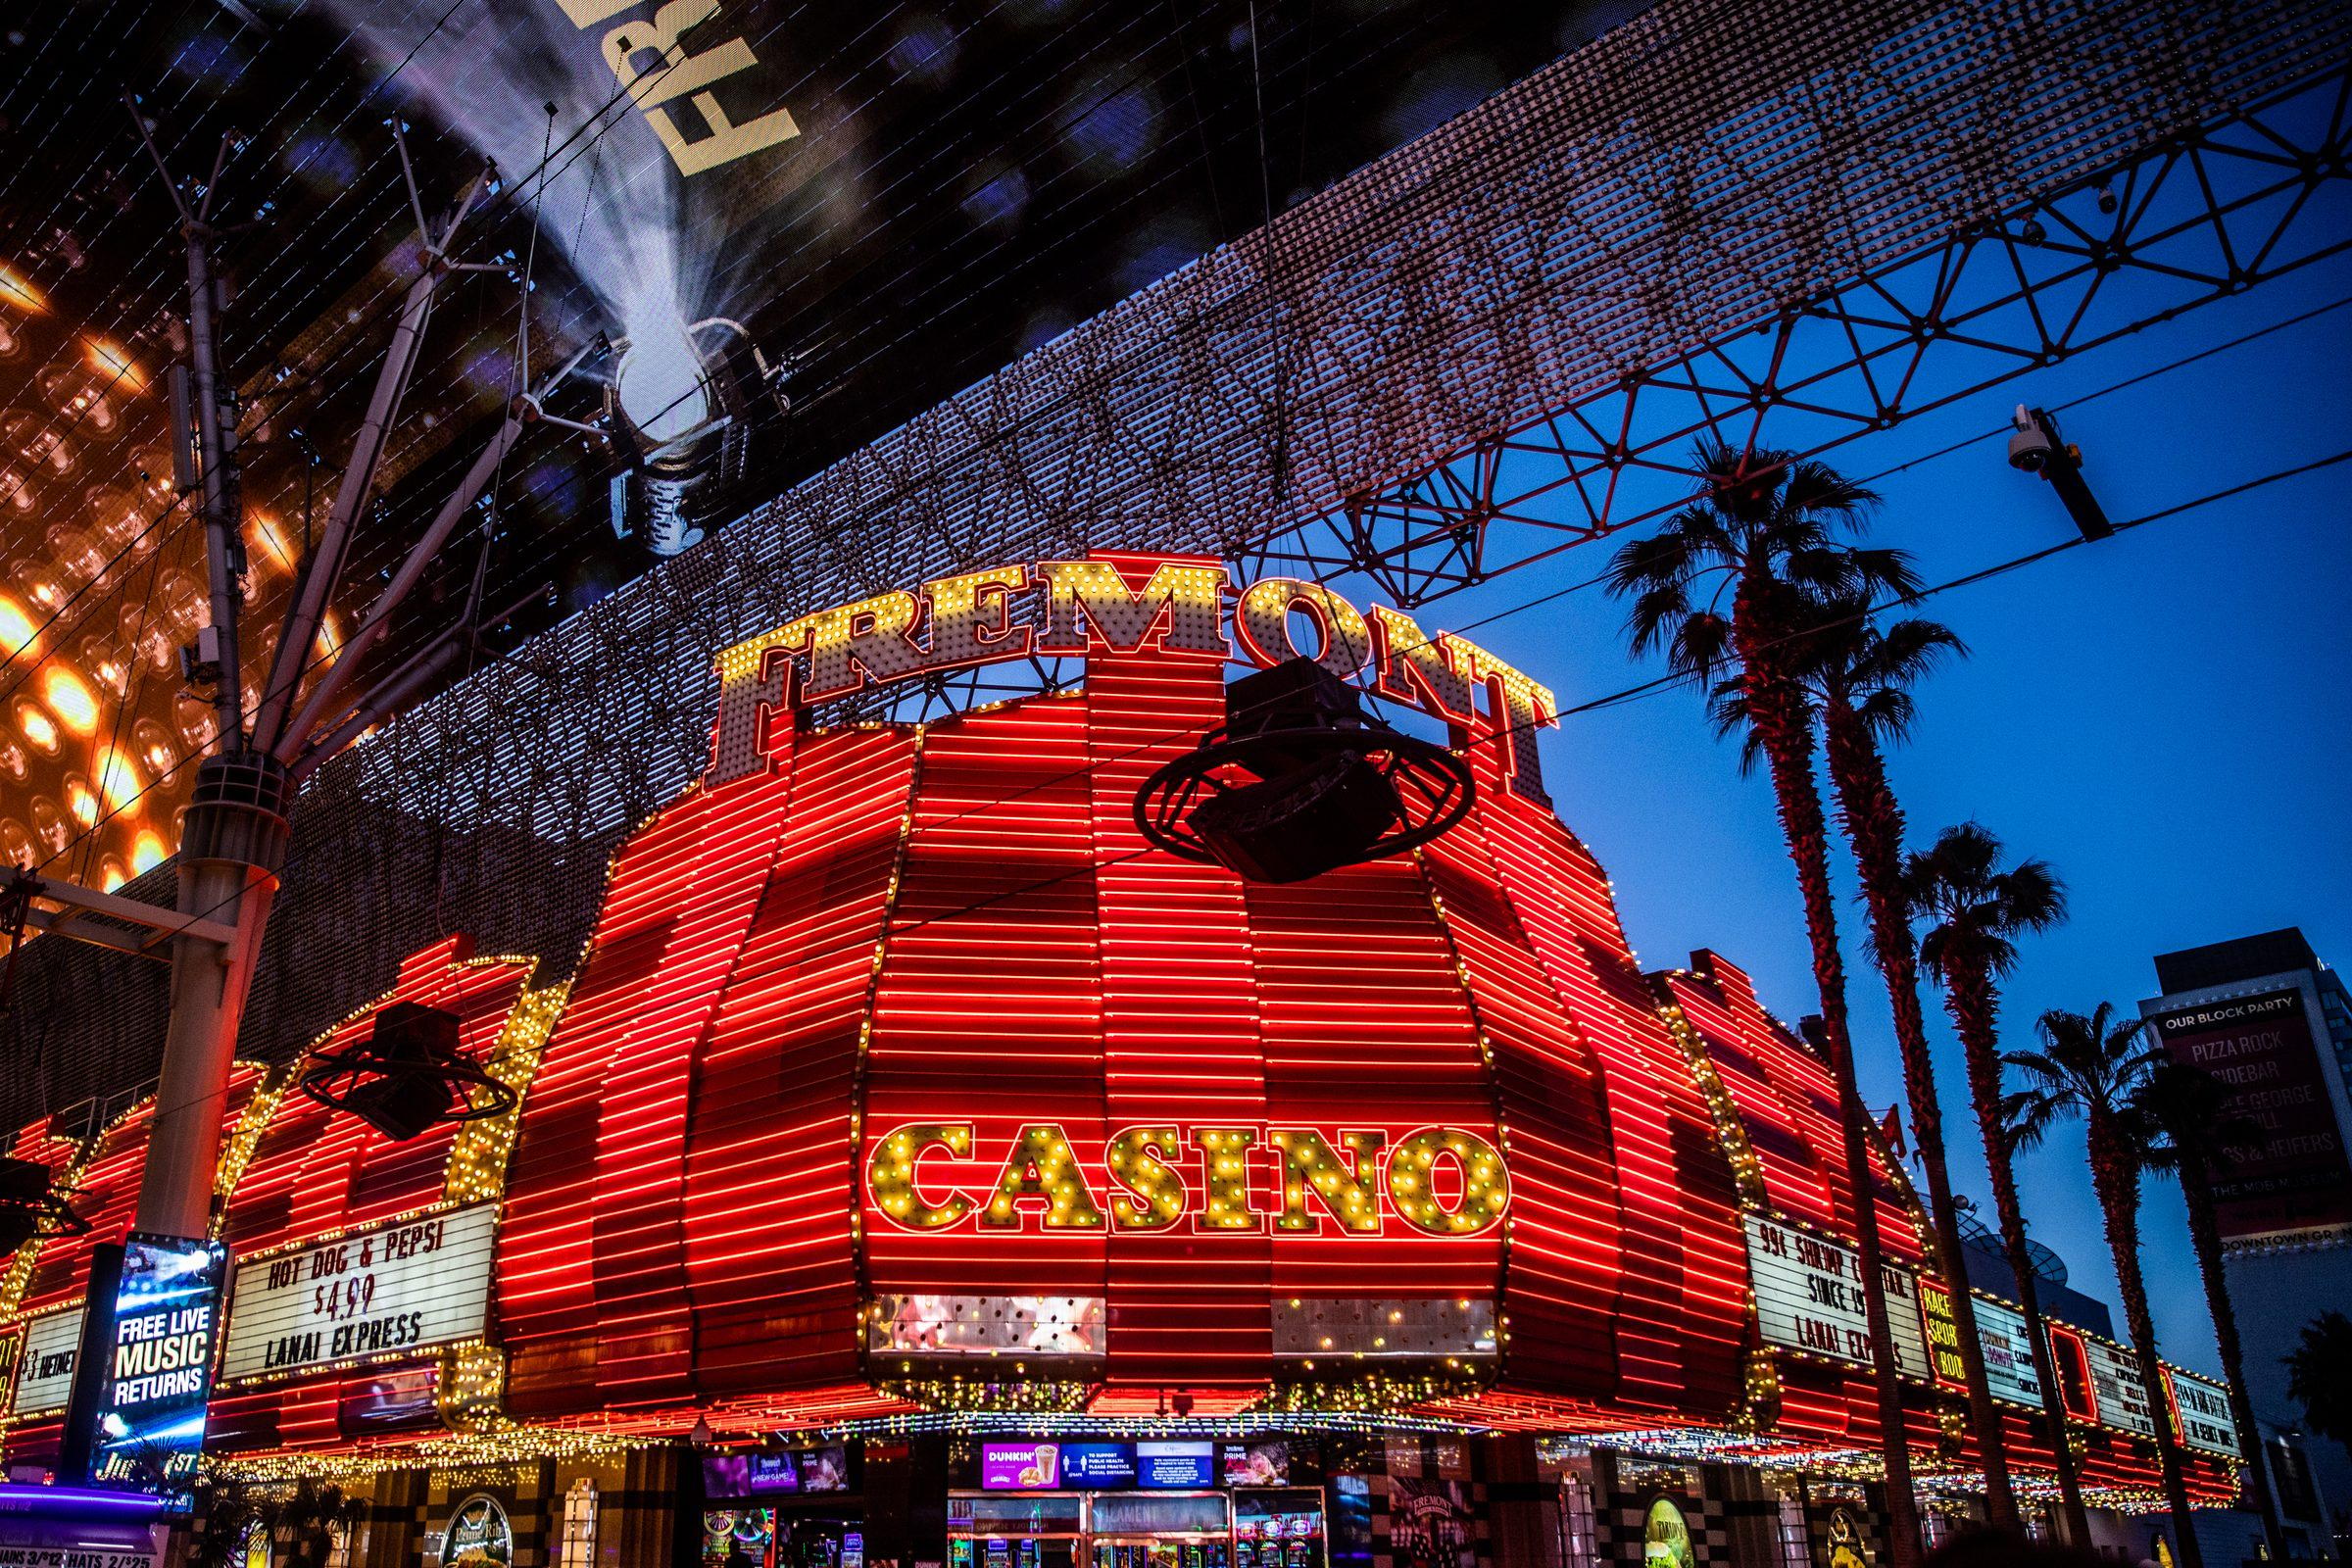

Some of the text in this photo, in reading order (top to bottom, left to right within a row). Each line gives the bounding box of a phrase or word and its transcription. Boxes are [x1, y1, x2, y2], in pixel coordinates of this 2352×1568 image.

[702, 561, 1560, 815] FREMONT
[2166, 997, 2294, 1030] OUR BLOCK PARTY
[2191, 1030, 2284, 1062] PIZZA ROCK
[2211, 1060, 2281, 1085] SIDEBAR
[2249, 1084, 2316, 1110] GEORGE
[866, 1122, 1511, 1238] CASINO
[2211, 1183, 2240, 1200] THE
[267, 1220, 444, 1291] HOT DOG & PEPSI
[1794, 1236, 1843, 1277] SHRIMP
[2221, 1233, 2308, 1251] DOWNTOWN
[314, 1274, 375, 1322] $4.99
[1807, 1274, 1848, 1312] SINCE
[1923, 1287, 1952, 1318] RACE
[118, 1306, 210, 1344] FREE LIVE
[264, 1311, 422, 1369] LANAI EXPRESS
[1794, 1314, 1841, 1353] LANAI
[115, 1331, 208, 1380] MUSIC
[115, 1368, 203, 1405] RETURNS
[989, 1451, 1035, 1462] DUNKIN'
[1411, 1495, 1452, 1510] FREMONT
[68, 1553, 103, 1568] HATS
[109, 1555, 150, 1568] 2/$25
